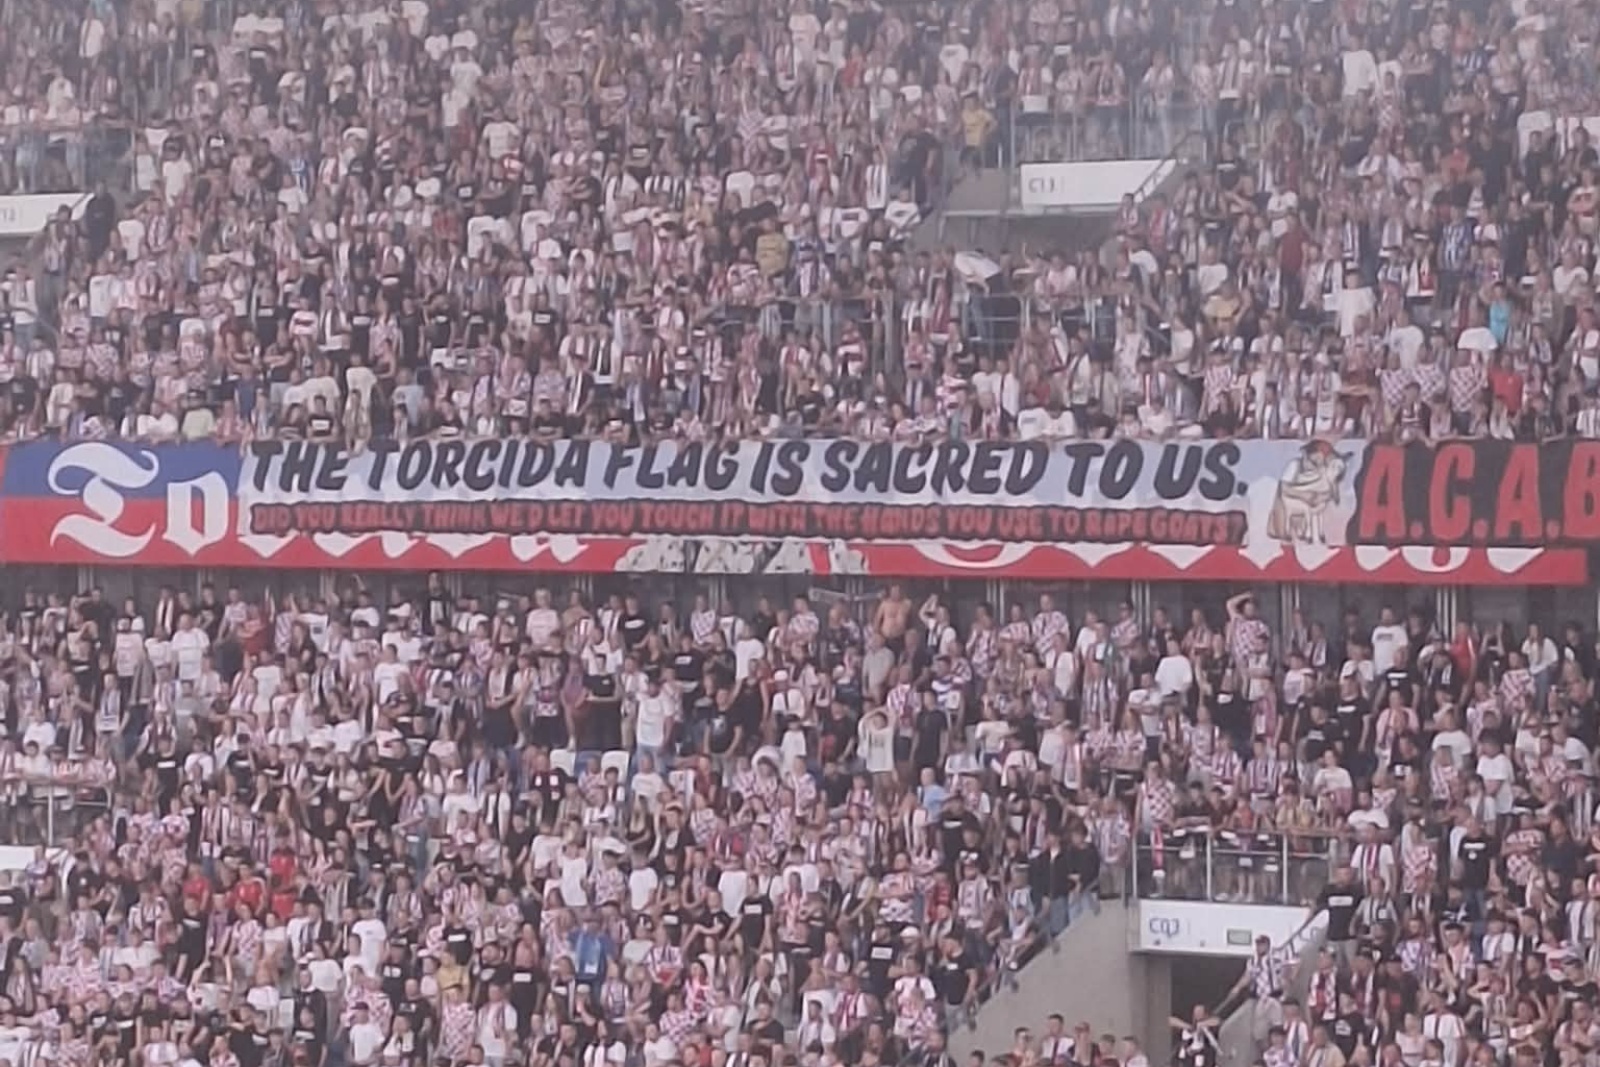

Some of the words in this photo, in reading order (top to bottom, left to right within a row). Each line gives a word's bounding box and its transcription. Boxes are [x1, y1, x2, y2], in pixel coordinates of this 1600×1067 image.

[251, 440, 350, 493] THE
[367, 439, 591, 492] TORCIDA
[603, 440, 740, 491] FLAG
[750, 441, 812, 497] IS
[820, 440, 1050, 498] SACRED
[1065, 440, 1144, 500] TO
[1153, 441, 1248, 501] US.
[253, 505, 292, 530] DID
[294, 504, 336, 530] YOU
[341, 503, 416, 529] REALLY
[422, 503, 486, 530] THINK
[489, 503, 544, 529] WE'D
[547, 503, 584, 528] LET
[591, 503, 635, 529] YOU
[641, 503, 715, 530] TOUCH
[719, 503, 746, 529] IT
[748, 505, 806, 531] WITH
[811, 506, 859, 532] THE
[860, 506, 940, 534] HANDS
[946, 506, 993, 534] YOU
[999, 507, 1044, 537] USE
[1047, 508, 1080, 536] TO
[1083, 509, 1148, 539] RAPE
